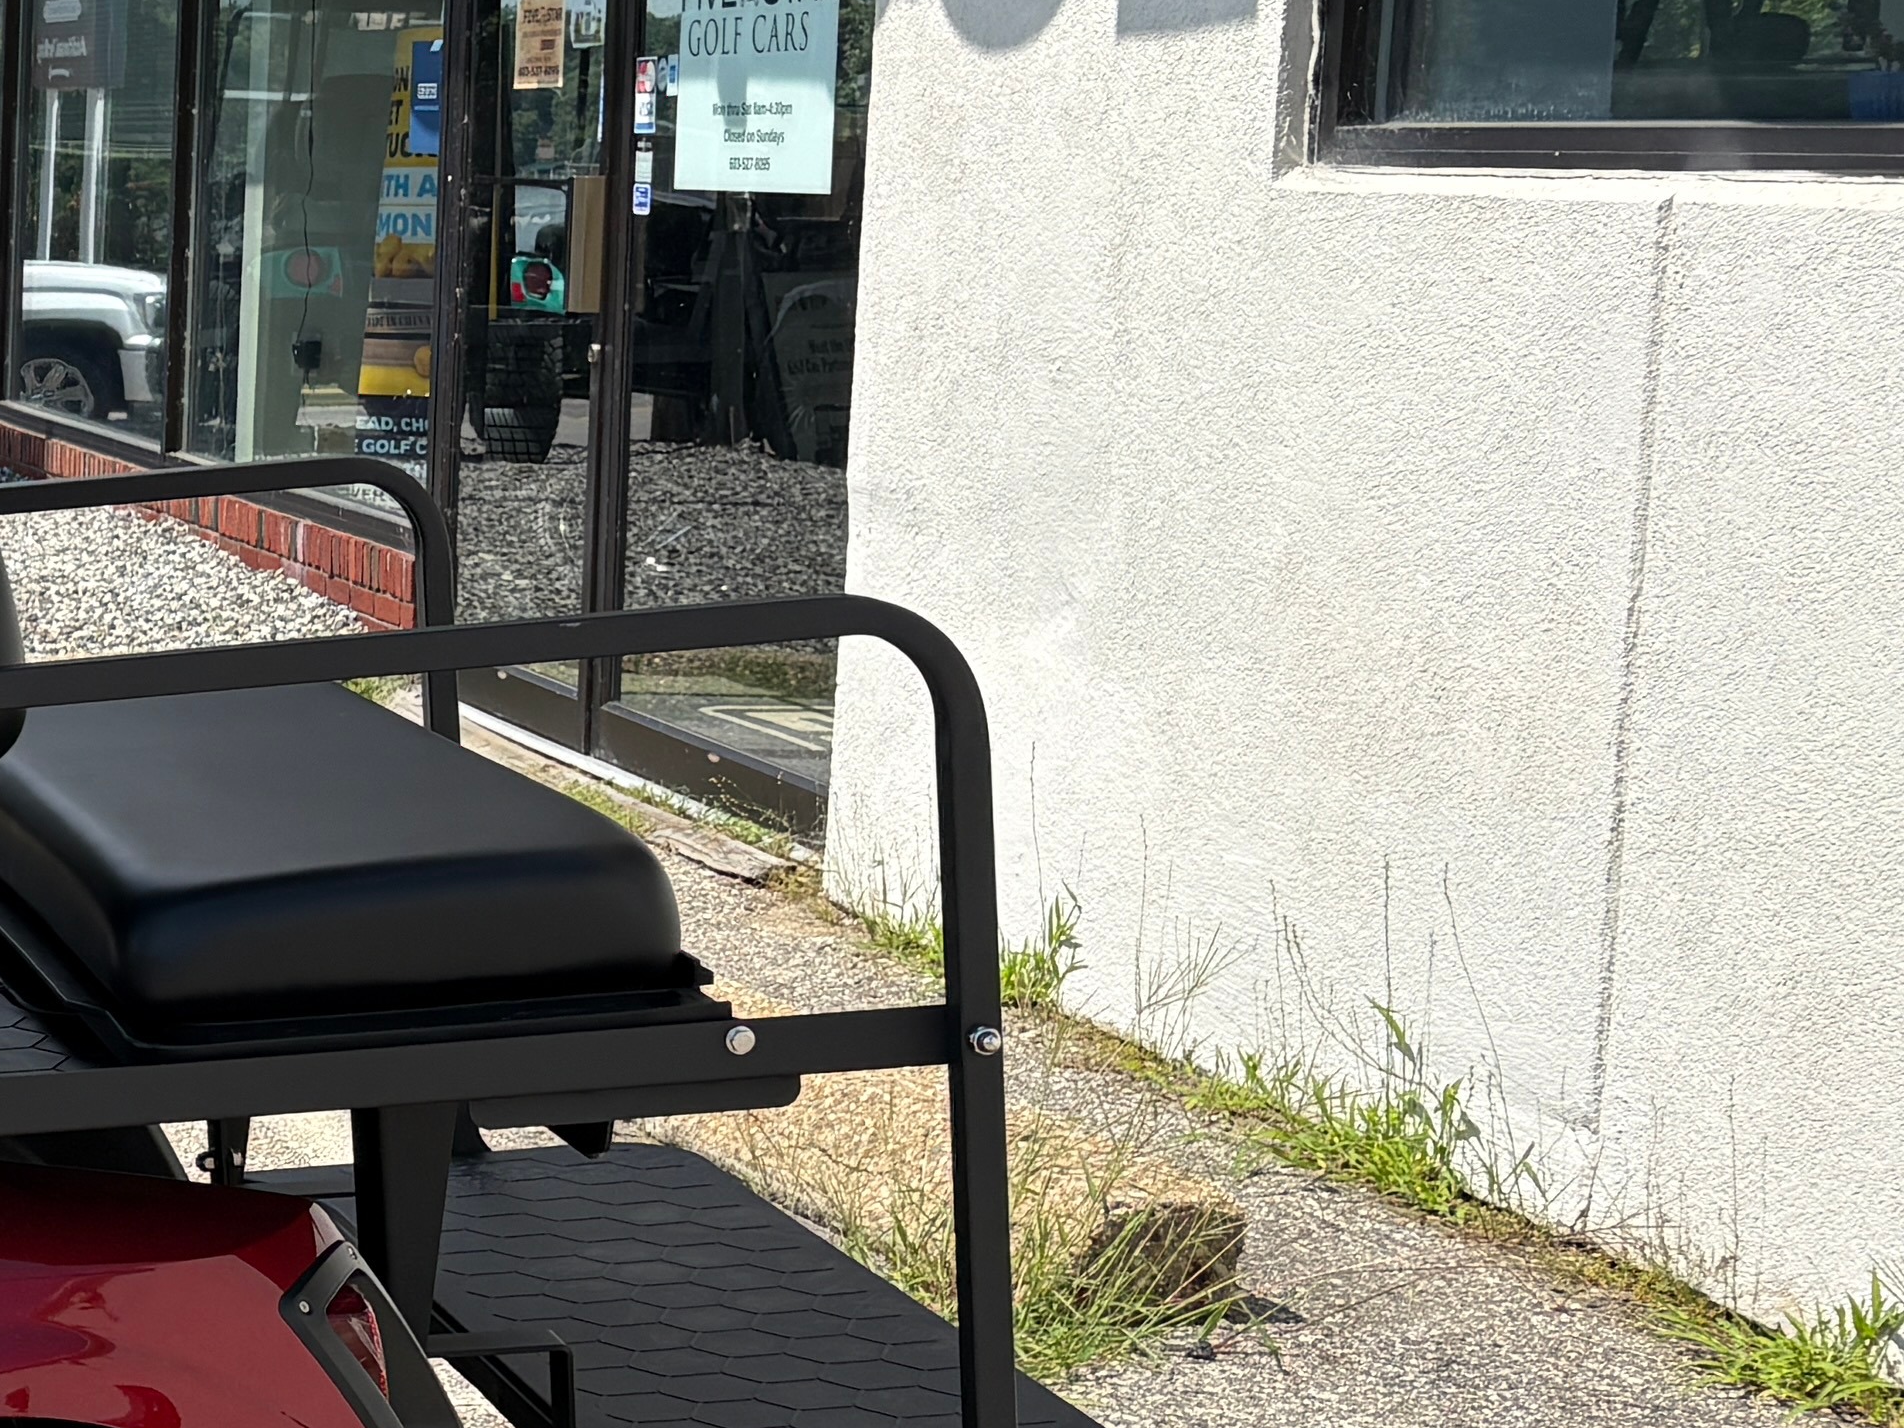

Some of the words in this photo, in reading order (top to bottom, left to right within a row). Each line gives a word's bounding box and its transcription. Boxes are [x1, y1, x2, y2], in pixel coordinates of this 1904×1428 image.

[688, 17, 743, 57] GOLF
[752, 11, 810, 53] CARS
[383, 174, 410, 198] TH
[362, 438, 412, 455] GOLF
